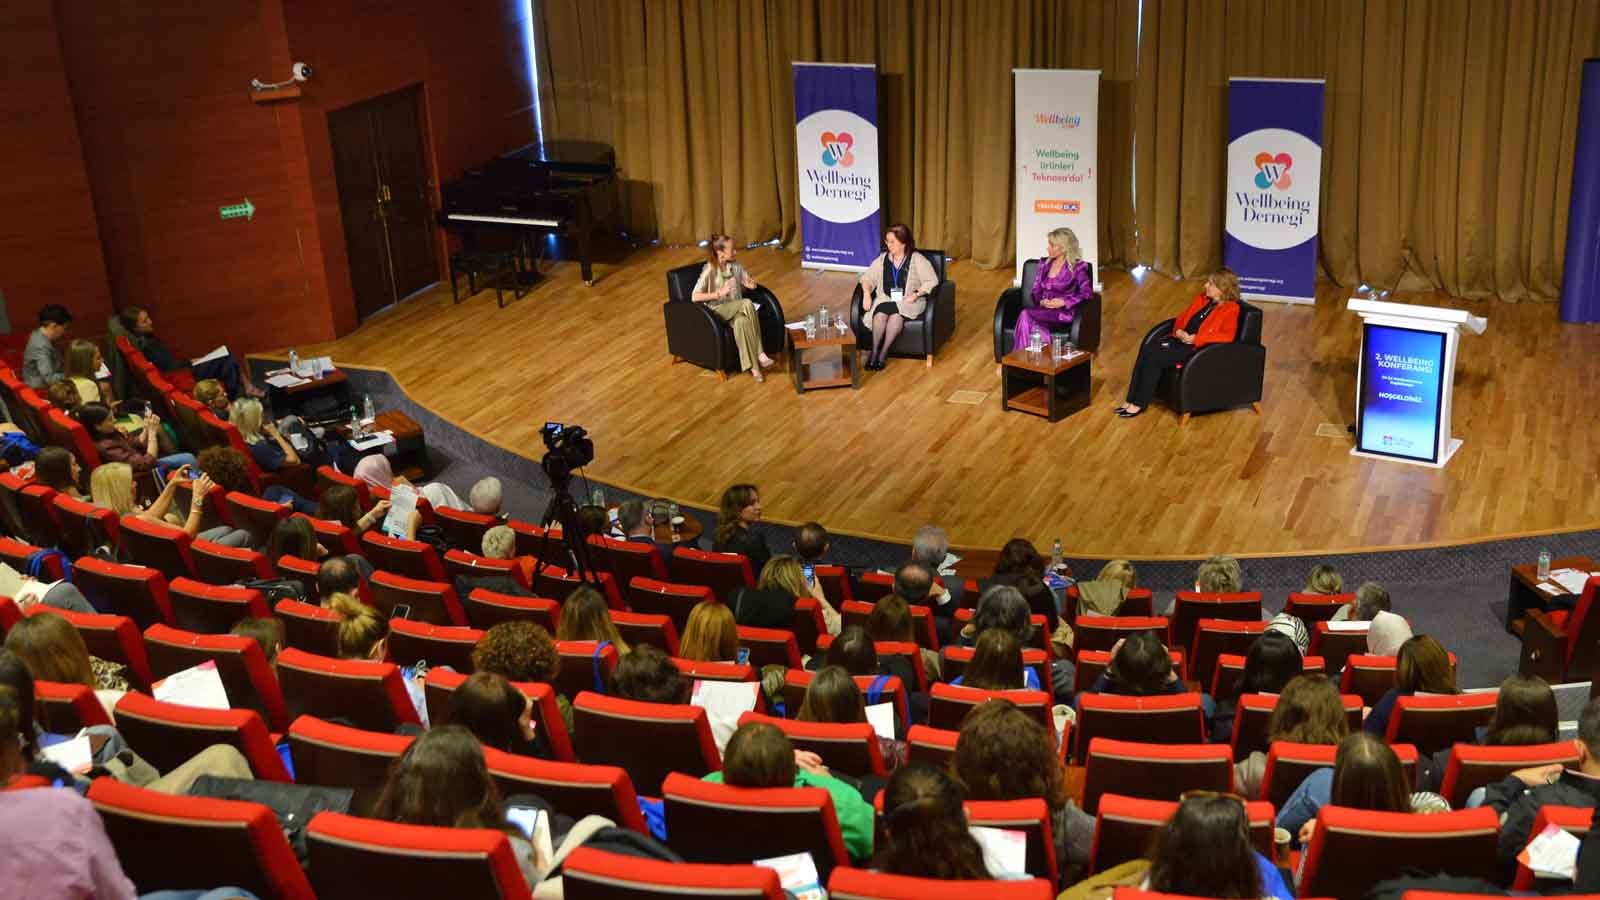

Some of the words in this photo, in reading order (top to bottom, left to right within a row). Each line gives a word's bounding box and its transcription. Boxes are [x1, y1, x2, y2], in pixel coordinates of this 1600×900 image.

[829, 143, 847, 160] W
[1036, 149, 1079, 160] Wellbeing
[806, 168, 872, 190] Wellbeing
[1264, 165, 1286, 182] W
[1235, 191, 1310, 214] Wellbeing
[1384, 354, 1434, 367] WELLBEING
